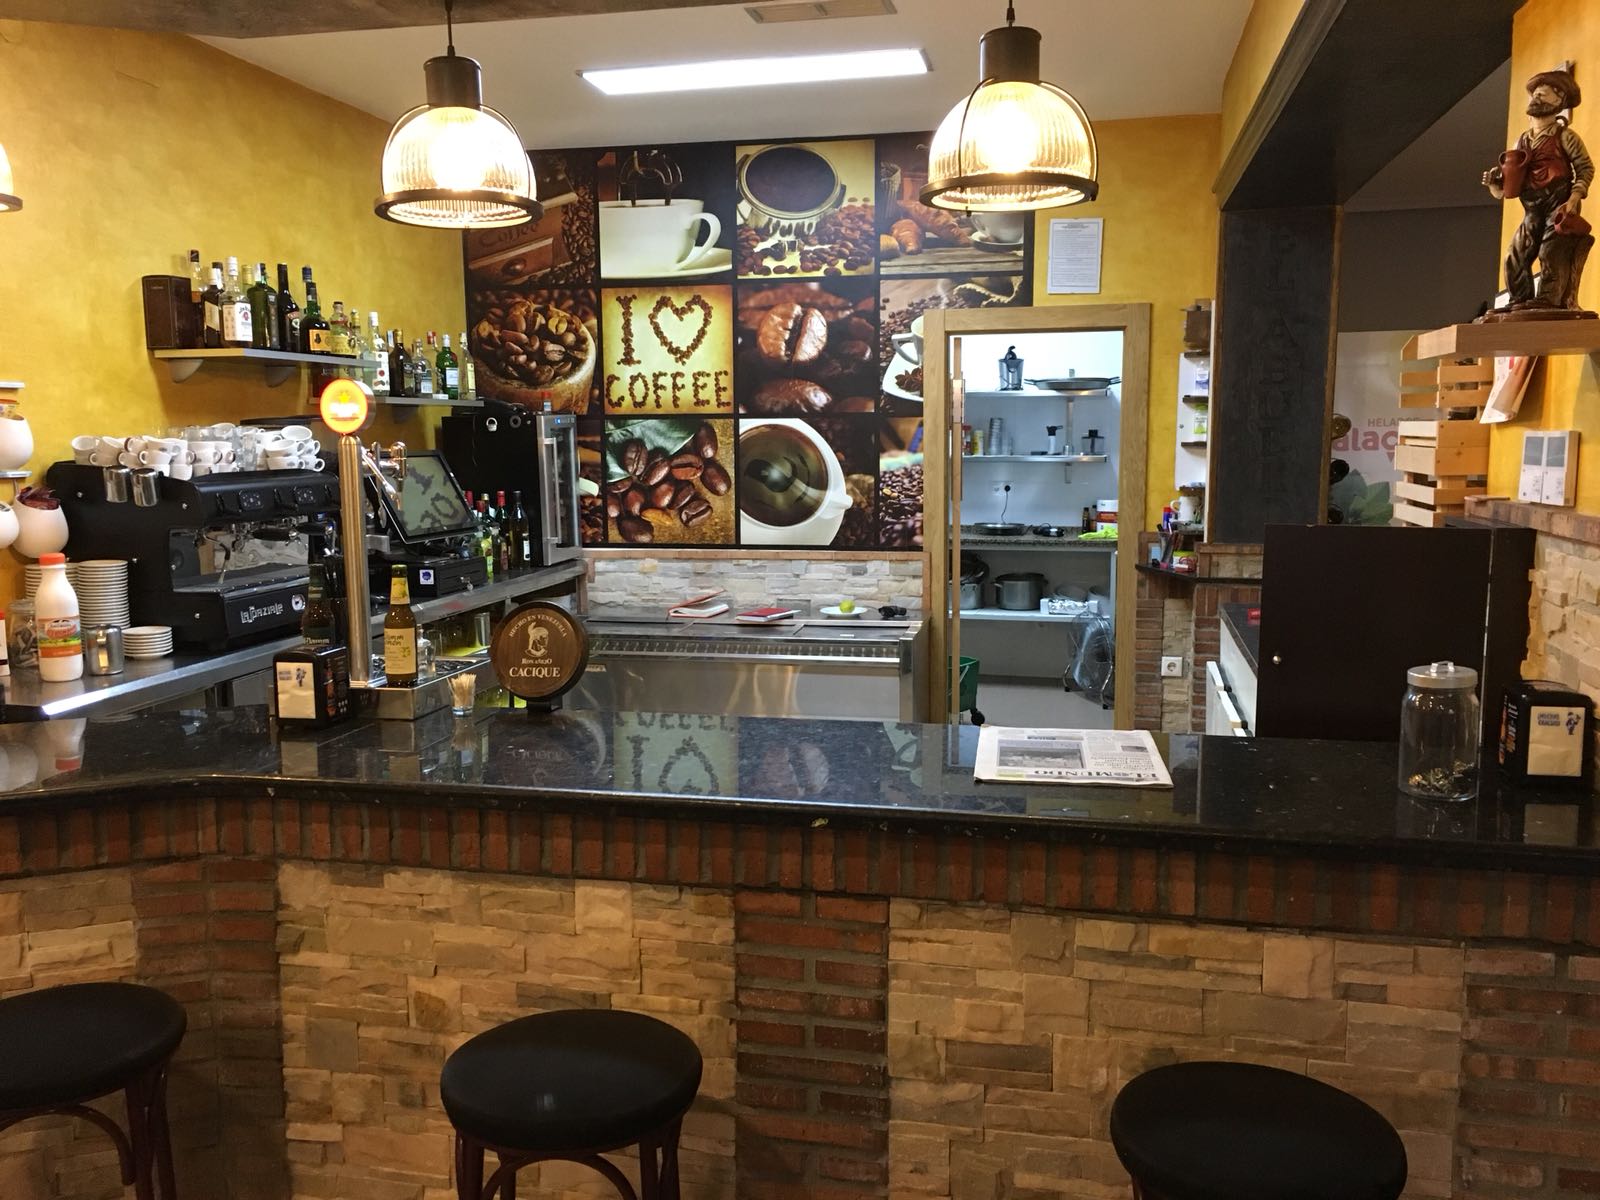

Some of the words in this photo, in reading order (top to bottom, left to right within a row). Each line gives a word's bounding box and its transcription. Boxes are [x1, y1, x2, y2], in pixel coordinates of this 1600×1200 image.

[616, 295, 640, 365] I
[605, 371, 731, 409] COFFEE
[509, 618, 527, 637] HECHO
[509, 667, 561, 678] CACIQUE
